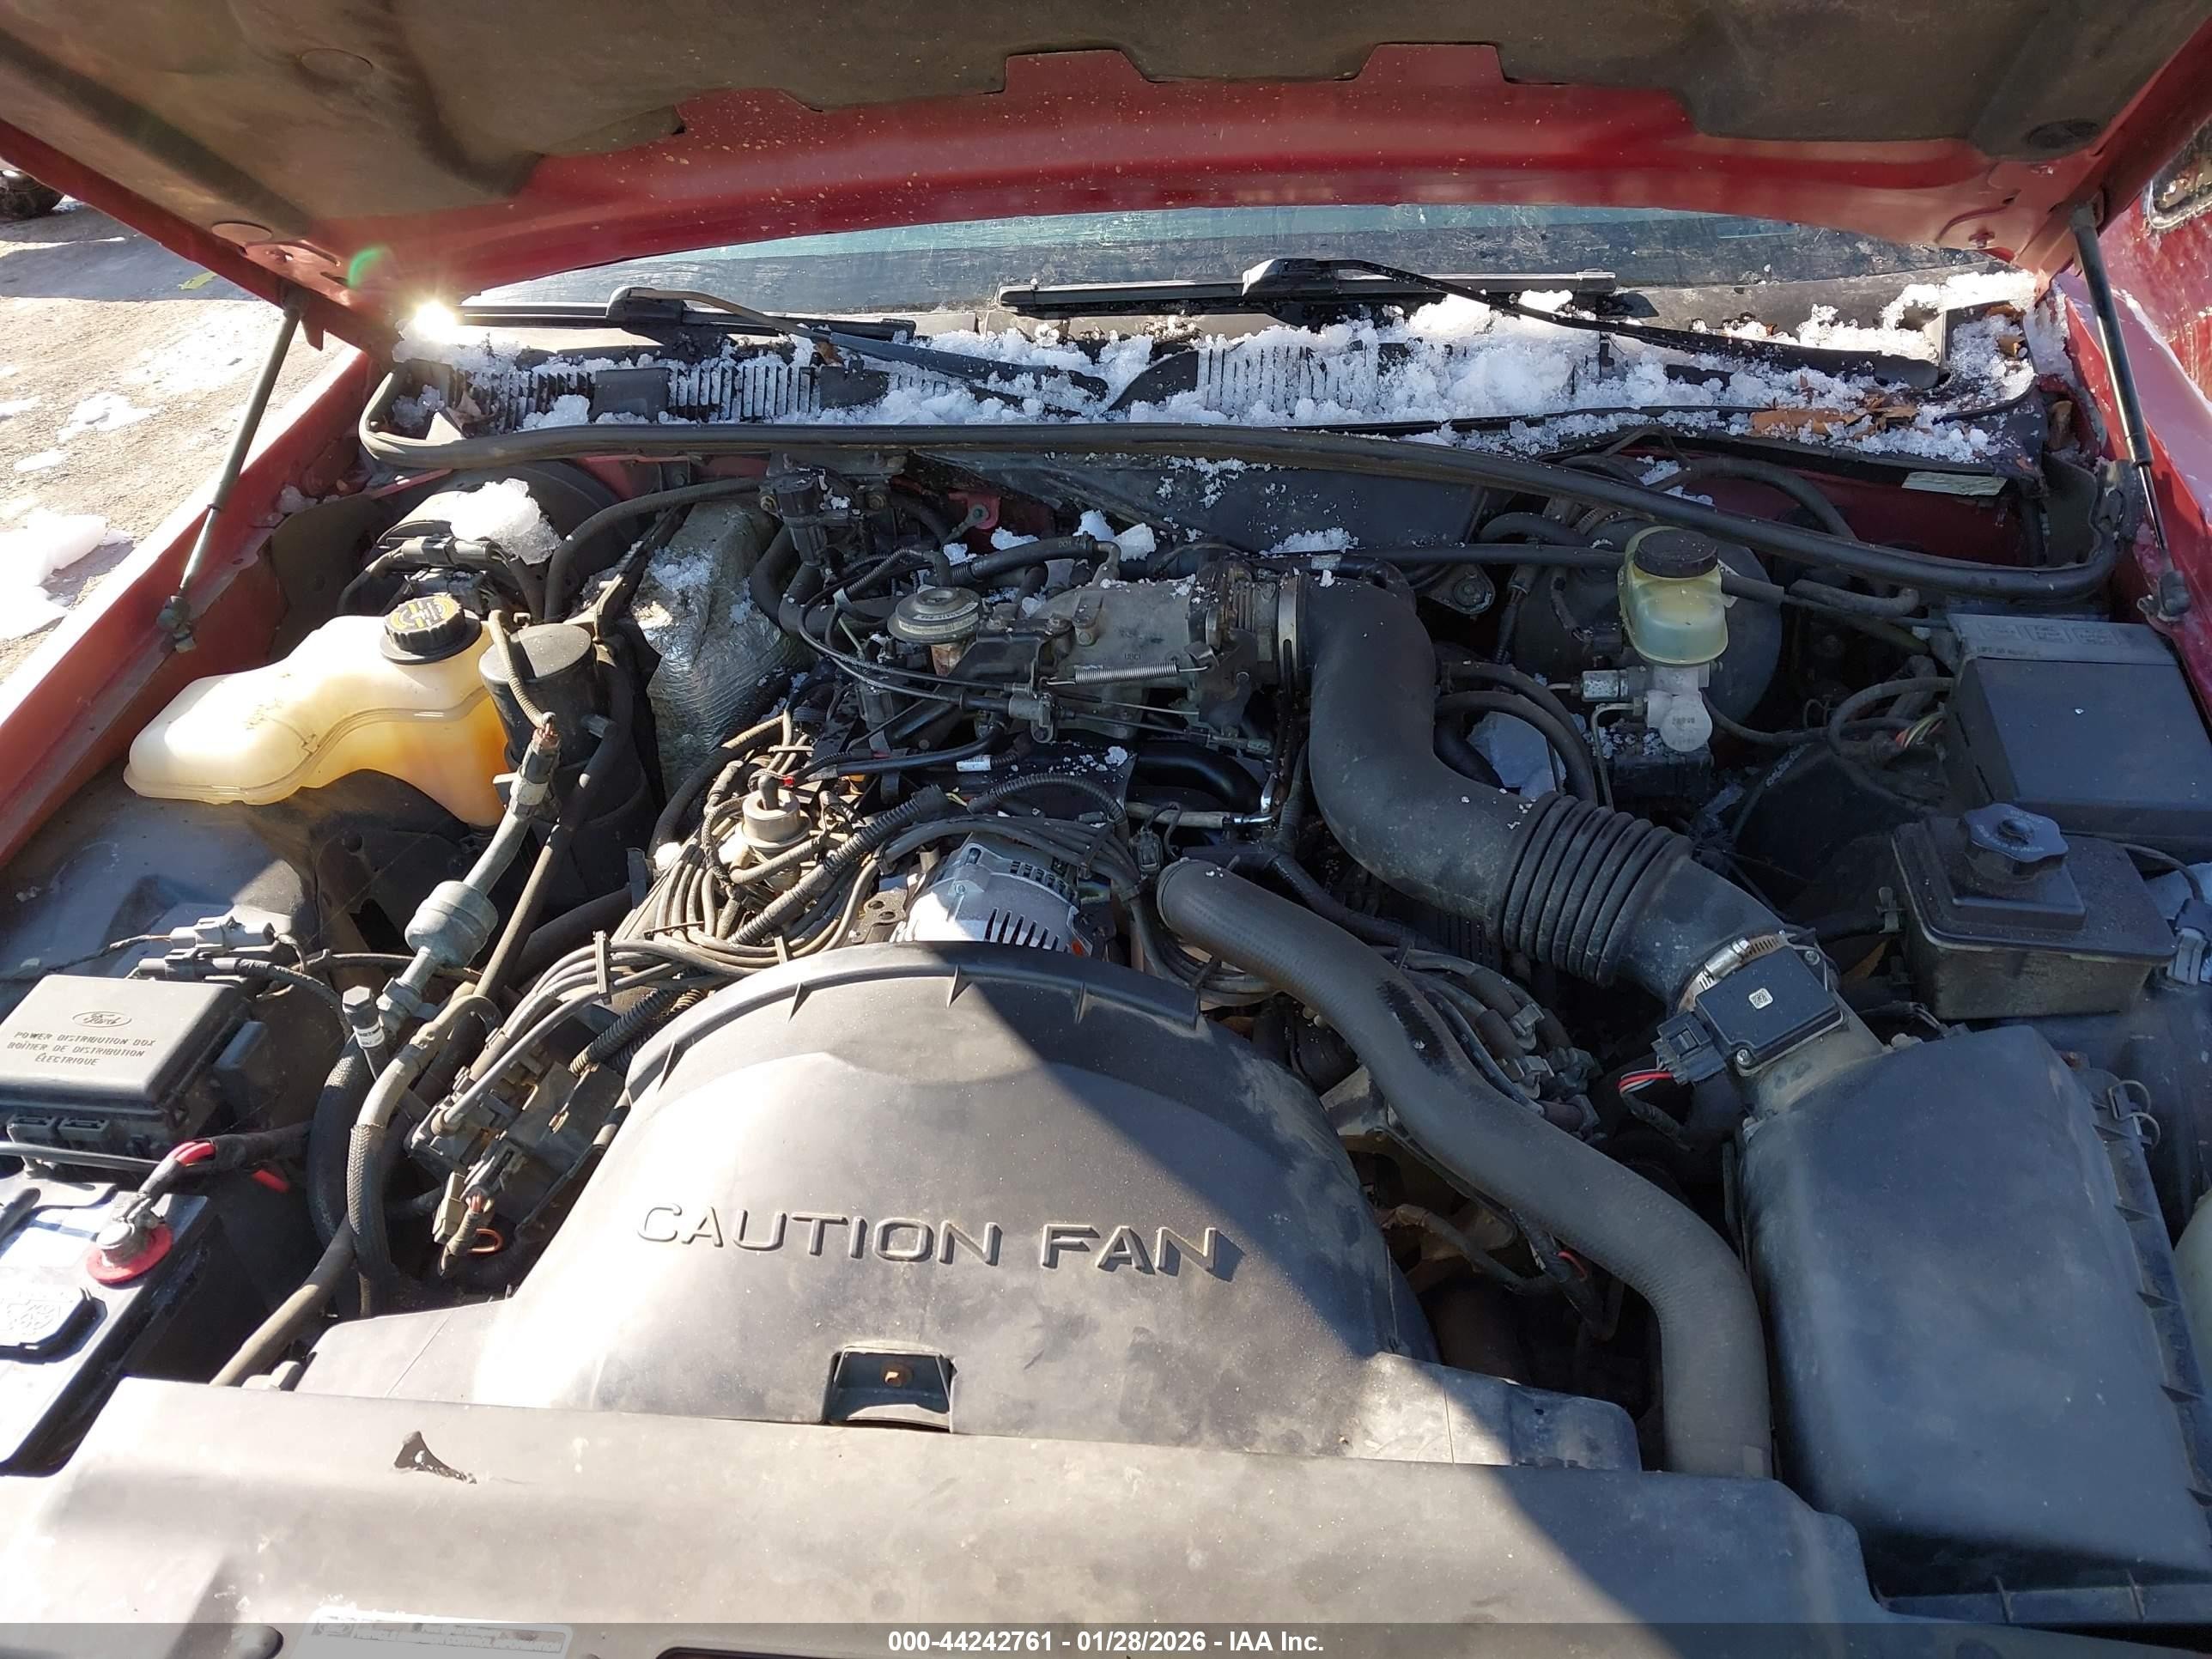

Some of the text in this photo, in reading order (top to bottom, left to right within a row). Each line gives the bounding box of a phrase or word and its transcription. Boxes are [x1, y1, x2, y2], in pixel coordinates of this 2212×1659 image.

[83, 1012, 120, 1025] Ford
[14, 1031, 52, 1041] POWER
[58, 1034, 128, 1045] DISTRIBUTION
[72, 1045, 145, 1057] DISTRIBUTION
[636, 1203, 1230, 1279] CAUTION FAN
